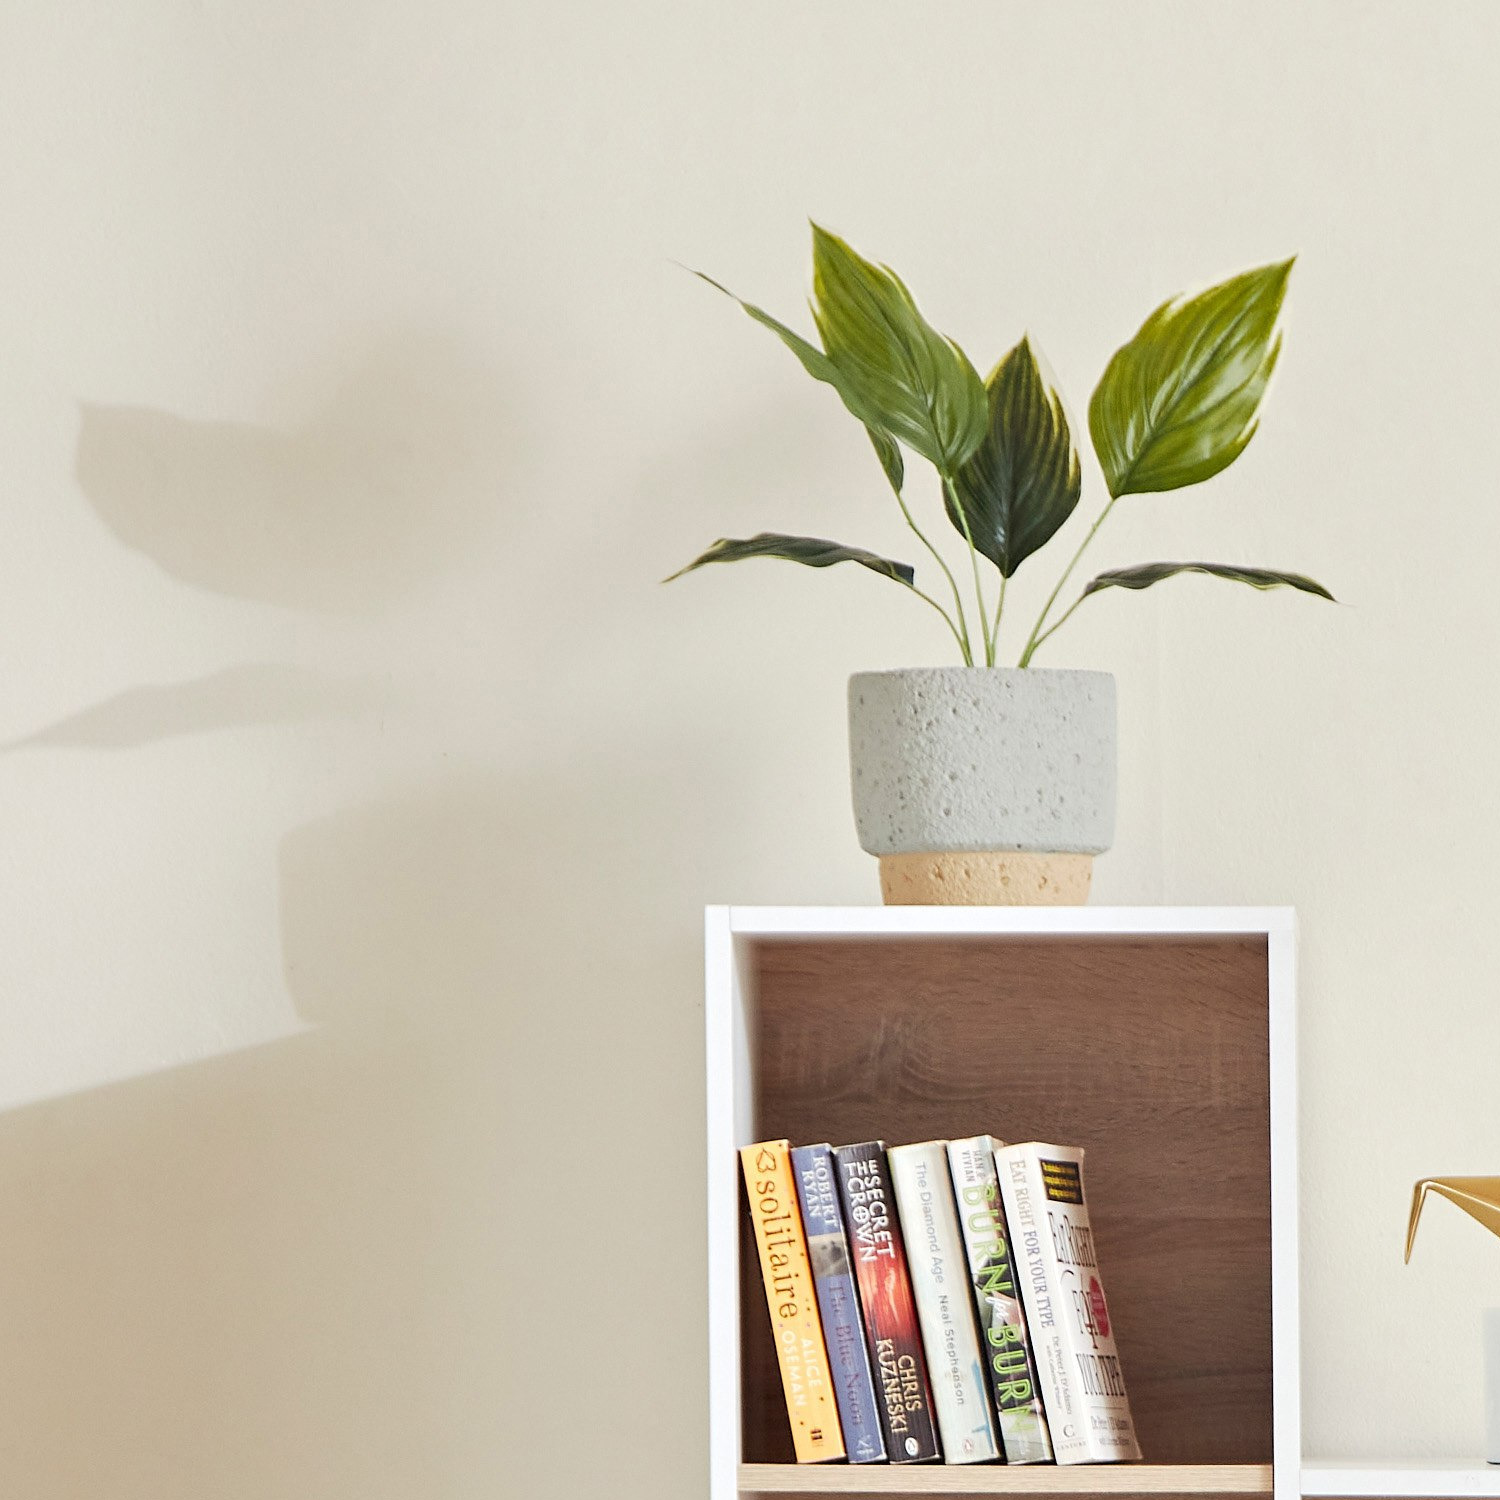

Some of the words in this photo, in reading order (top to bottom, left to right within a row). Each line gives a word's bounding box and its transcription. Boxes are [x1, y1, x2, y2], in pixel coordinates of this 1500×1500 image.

[802, 1170, 822, 1218] RYAN
[813, 1156, 839, 1227] ROBERT
[844, 1159, 880, 1177] THE
[915, 1162, 927, 1188] The
[1009, 1159, 1027, 1184] EAT
[847, 1177, 878, 1263] CROWN
[864, 1175, 896, 1260] SECRET
[920, 1191, 941, 1253] Diamond
[1015, 1187, 1036, 1227] RIGHT
[756, 1181, 799, 1318] solitaire
[962, 1184, 1013, 1294] BURN
[1024, 1231, 1041, 1258] FOR
[930, 1257, 945, 1284] Age
[1029, 1259, 1049, 1295] YOUR
[938, 1294, 953, 1326] Neal
[1038, 1297, 1055, 1329] TYPE
[781, 1330, 808, 1407] OSEMAN
[801, 1338, 822, 1388] ALICE
[876, 1338, 909, 1433] KUZNESKI
[897, 1354, 922, 1412] CHRIS
[944, 1329, 965, 1406] Stephenson
[987, 1323, 1036, 1433] BURN
